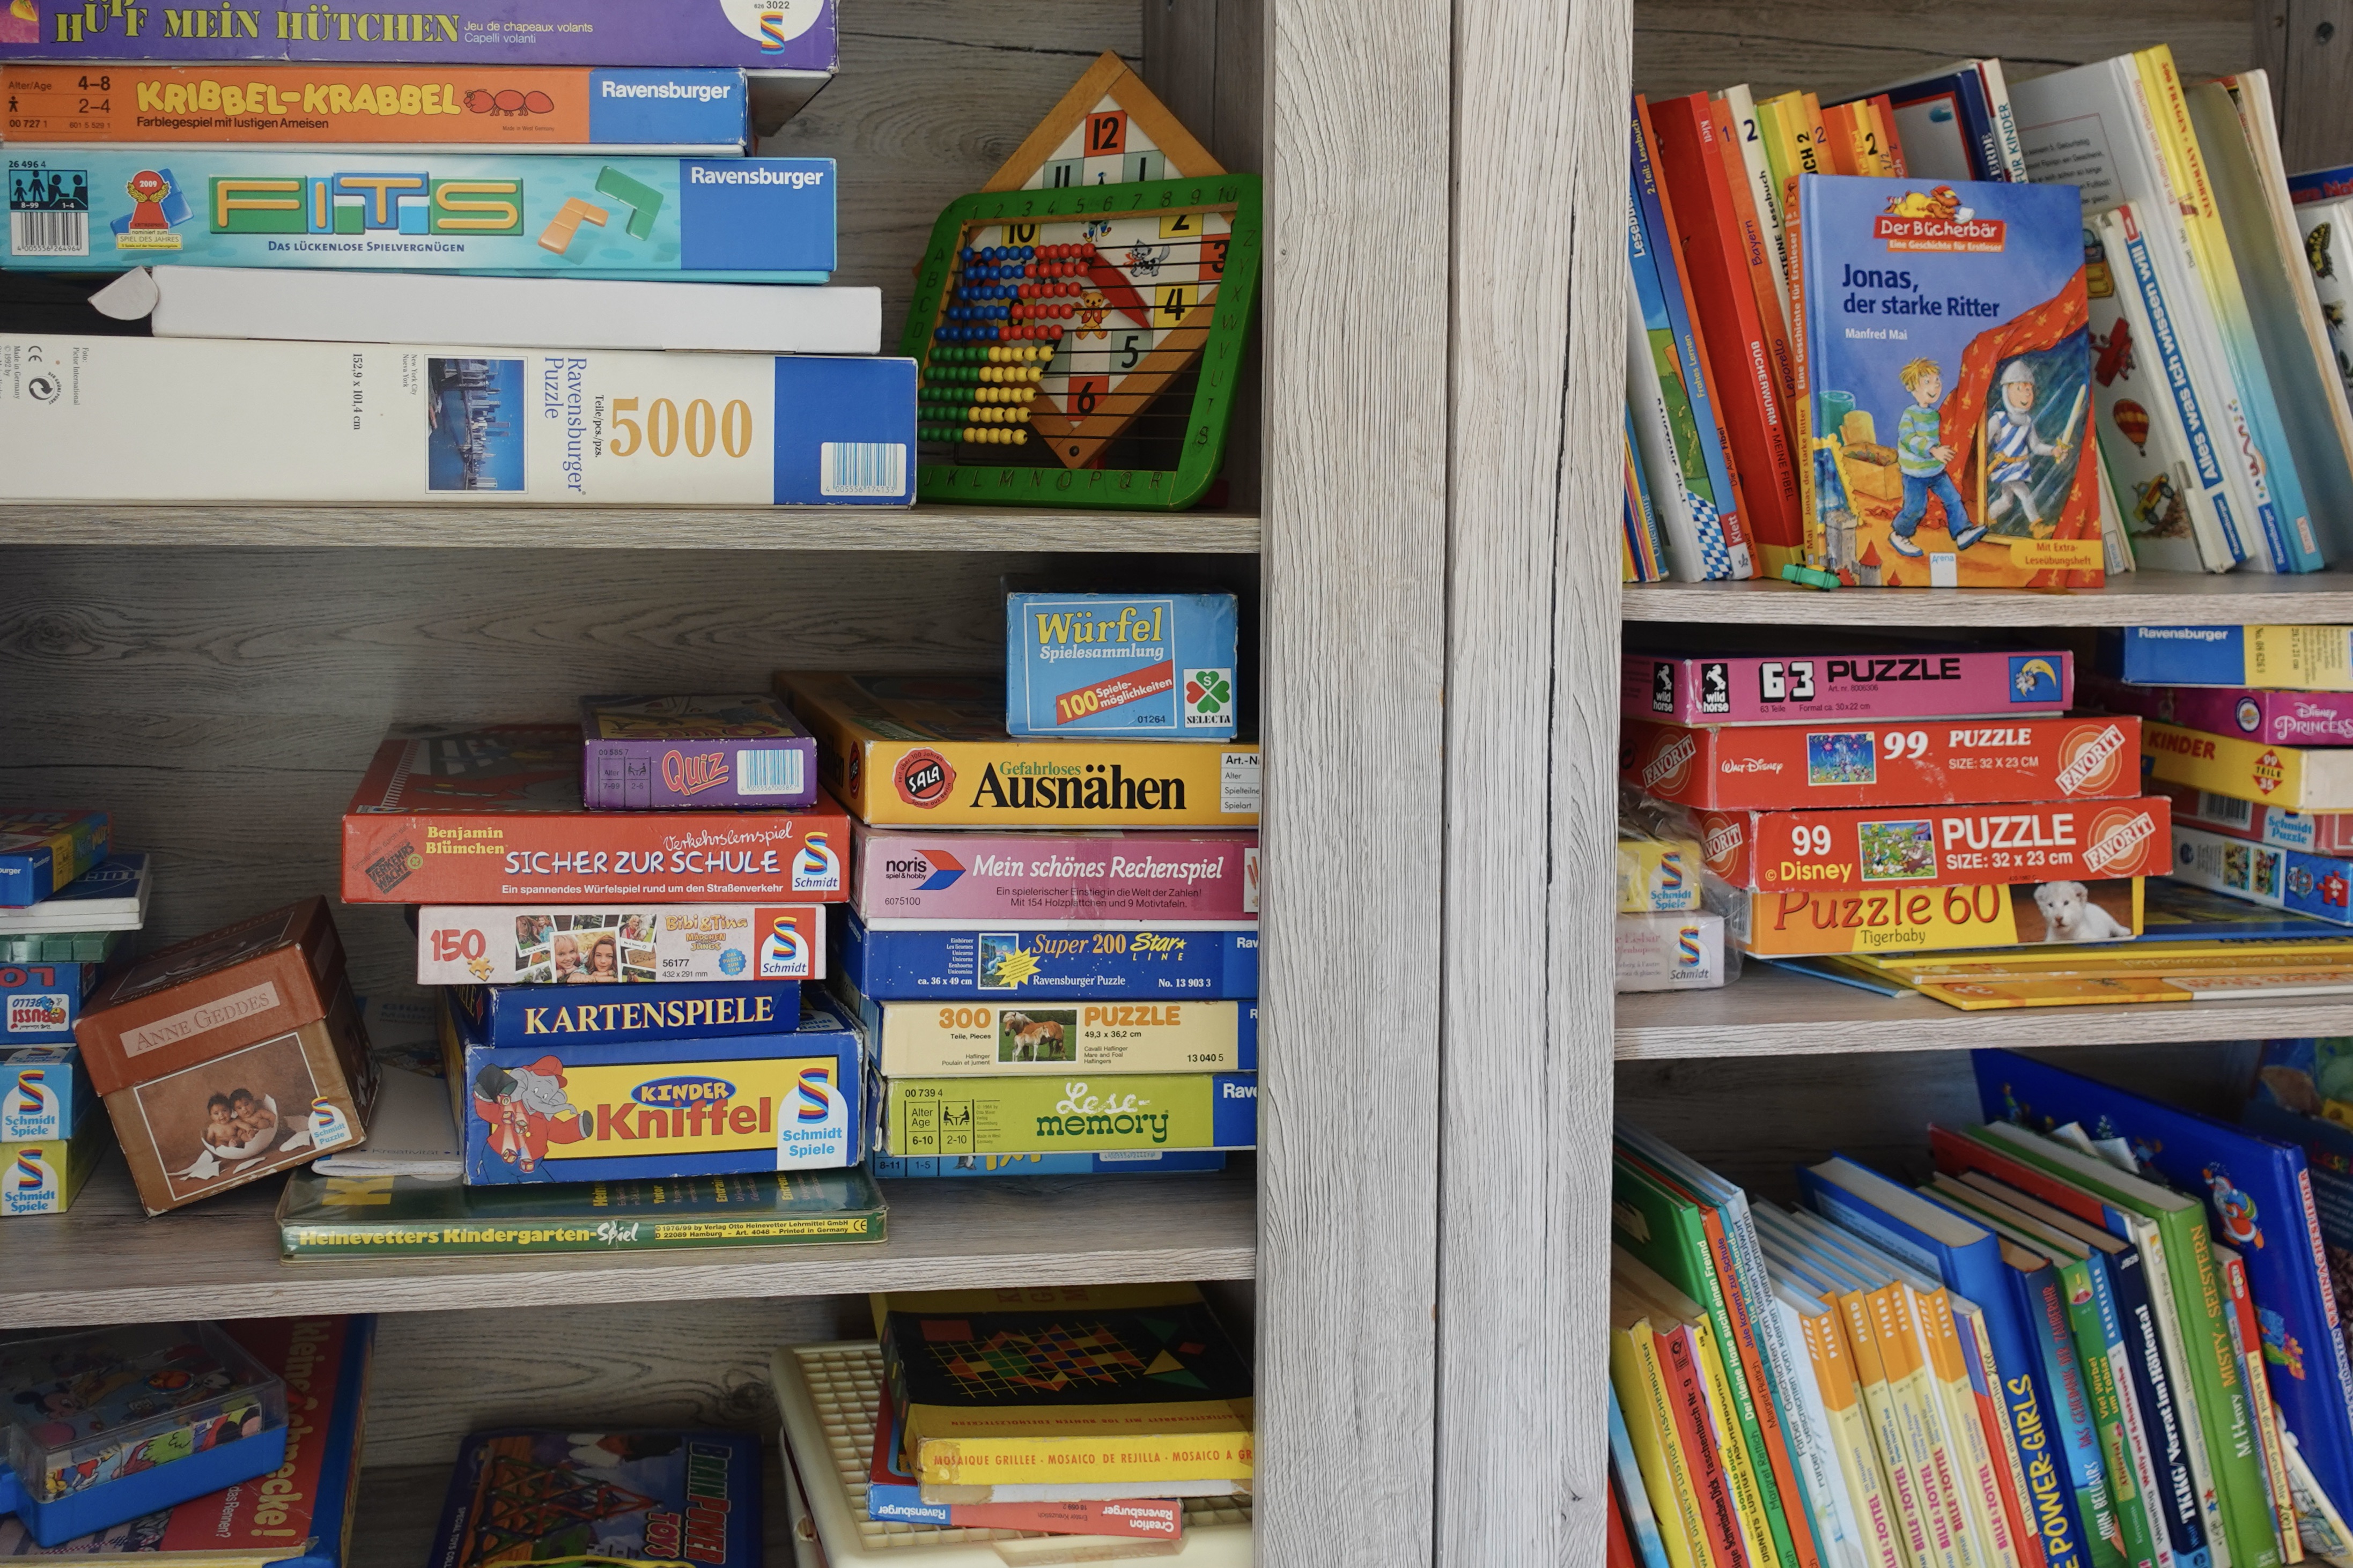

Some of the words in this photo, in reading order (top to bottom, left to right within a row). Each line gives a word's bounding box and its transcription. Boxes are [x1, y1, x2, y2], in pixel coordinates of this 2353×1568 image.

[164, 1, 261, 38] MEIN
[277, 4, 460, 42] HÜTCHEN
[464, 22, 484, 32] Jeu
[487, 22, 500, 31] de
[504, 22, 553, 33] chapeaux
[557, 23, 593, 32] volants
[9, 81, 51, 91] Alter/Age
[136, 80, 462, 116] KRIBBEL-KRABBEL
[602, 82, 730, 102] Ravensburger
[137, 117, 212, 129] Farblegespiel
[215, 117, 232, 128] mit
[234, 117, 277, 131] lustigen
[279, 118, 328, 129] Ameisen
[1092, 116, 1119, 151] 12
[691, 167, 824, 190] Ravensburger
[209, 171, 524, 236] FITS
[1759, 169, 1780, 228] Lesebuch
[1880, 219, 1908, 235] Der
[1913, 220, 1997, 237] Bücherbär
[2131, 245, 2151, 282] will
[1842, 263, 1919, 293] Jonas,
[1164, 288, 1185, 321] 4
[1843, 293, 1876, 314] der
[1881, 294, 1942, 316] starke
[1946, 297, 2000, 317] Ritter
[2146, 283, 2175, 355] wissen
[1845, 328, 1886, 340] Manfred
[1889, 329, 1908, 341] Mai
[1121, 336, 1139, 368] 5
[352, 353, 363, 379] 152,9
[1774, 338, 1796, 398] Leporello
[2168, 356, 2187, 388] ich
[544, 357, 564, 419] Puzzle
[1751, 341, 1777, 425] BÜCHERWURM
[353, 389, 363, 414] 101,4
[1077, 382, 1095, 414] 6
[2179, 389, 2200, 431] was
[353, 416, 360, 430] cm
[564, 357, 587, 490] Ravensburger
[594, 395, 604, 458] Teile/pcs./pzs.
[610, 396, 753, 458] 5000
[2194, 437, 2218, 480] Alles
[1727, 515, 1743, 543] Klett
[1931, 553, 1955, 564] Arena
[2037, 542, 2050, 552] Mit
[2053, 543, 2078, 553] Extra-
[2025, 554, 2092, 567] Leseübungsheft
[1035, 606, 1163, 645] Würfel
[2138, 627, 2229, 641] Ravensburger
[1039, 645, 1164, 664] Spielesammlung
[1096, 680, 1132, 698] Spiele-
[1100, 677, 1173, 708] möglichkeiten
[1759, 661, 1816, 703] 63
[1827, 658, 1961, 683] PUZZLE
[1059, 690, 1099, 720] 100
[1137, 715, 1166, 724] 01264
[1186, 714, 1231, 724] SELECTA
[1883, 730, 1929, 759] 99
[1949, 728, 2032, 749] PUZZLE
[2148, 729, 2217, 760] KINDER
[662, 750, 730, 796] Quiz
[1000, 761, 1081, 776] Gefahrloses
[2059, 729, 2122, 793] FAVORIT
[909, 763, 940, 793] SALA
[970, 762, 1186, 810] Ausnähen
[1225, 801, 1252, 810] Spielart
[427, 826, 504, 841] Benjamin
[663, 822, 794, 852] Verkehrslernspiel
[1791, 825, 1832, 856] 99
[1942, 813, 2077, 850] PUZZLE
[2088, 818, 2152, 869] FAVORIT
[426, 841, 505, 855] Blümchen
[505, 850, 606, 875] SICHER
[617, 852, 664, 874] ZUR
[671, 850, 781, 875] SCHULE
[886, 856, 927, 873] noris
[972, 854, 1024, 878] Mein
[1030, 855, 1105, 879] schönes
[1109, 856, 1223, 884] Rechenspiel
[1780, 861, 1852, 884] Disney
[1946, 854, 1988, 870] SIZE:
[1991, 852, 2012, 867] 32
[2015, 855, 2023, 866] x
[2026, 852, 2046, 866] 23
[2049, 852, 2073, 864] cm
[502, 885, 518, 893] Ein
[521, 885, 581, 895] spannendes
[584, 884, 640, 895] Würfelspiel
[643, 885, 666, 893] rund
[686, 884, 704, 892] den
[707, 884, 783, 893] Straßenverkehr
[794, 876, 838, 889] Schmidt
[884, 897, 920, 906] 6075100
[1774, 889, 1932, 930] Puzzle
[1943, 884, 2001, 925] 60
[430, 928, 486, 962] 150
[1032, 935, 1089, 958] Super
[1093, 934, 1126, 954] 200
[1860, 928, 1926, 946] Tigerbaby
[662, 958, 690, 967] 56177
[762, 961, 808, 974] Schmidt
[1033, 975, 1095, 988] Ravensburger
[1098, 975, 1126, 986] Puzzle
[135, 1022, 190, 1052] ANNE
[193, 992, 270, 1027] GEDDES
[524, 995, 774, 1036] KARTENSPIELE
[939, 1008, 991, 1029] 300
[1085, 1005, 1181, 1026] PUZZLE
[640, 1081, 731, 1103] KINDER
[1056, 1082, 1150, 1115] Lese-
[4, 1114, 56, 1126] Schmidt
[596, 1097, 772, 1141] Kniffel
[911, 1108, 933, 1116] Alter
[911, 1118, 931, 1128] Age
[10, 1126, 49, 1137] Spiele
[782, 1127, 843, 1142] Schmidt
[912, 1135, 934, 1145] 6-10
[947, 1135, 967, 1144] 2-10
[1037, 1112, 1168, 1143] memory
[789, 1143, 836, 1158] Spiele
[4, 1190, 56, 1202] Schmidt
[10, 1200, 49, 1213] Spiele
[300, 1230, 439, 1246] Heinevetters
[443, 1222, 639, 1245] Kindergarten-Spiel
[1697, 1240, 1715, 1277] Freund
[2298, 1167, 2340, 1330] WEIHNACHTSLIEDER
[2191, 1224, 2221, 1319] SEESTERN
[1707, 1278, 1723, 1307] einen
[1717, 1310, 1732, 1338] sucht
[1727, 1340, 1739, 1367] Hase
[2213, 1330, 2237, 1388] MISTY
[1736, 1370, 1750, 1401] kleine
[1745, 1406, 1754, 1421] Der
[934, 1455, 990, 1466] MOSAIQUE
[995, 1455, 1036, 1465] GRILLEE
[1048, 1454, 1095, 1465] MOSAICO
[1103, 1453, 1116, 1463] DE
[1121, 1452, 1160, 1463] REJILLA
[2007, 1374, 2074, 1553] POWER-GIRLS
[877, 1505, 946, 1520] Ravensburger
[1103, 1505, 1174, 1521] Ravensburger
[1129, 1519, 1174, 1533] Creation
